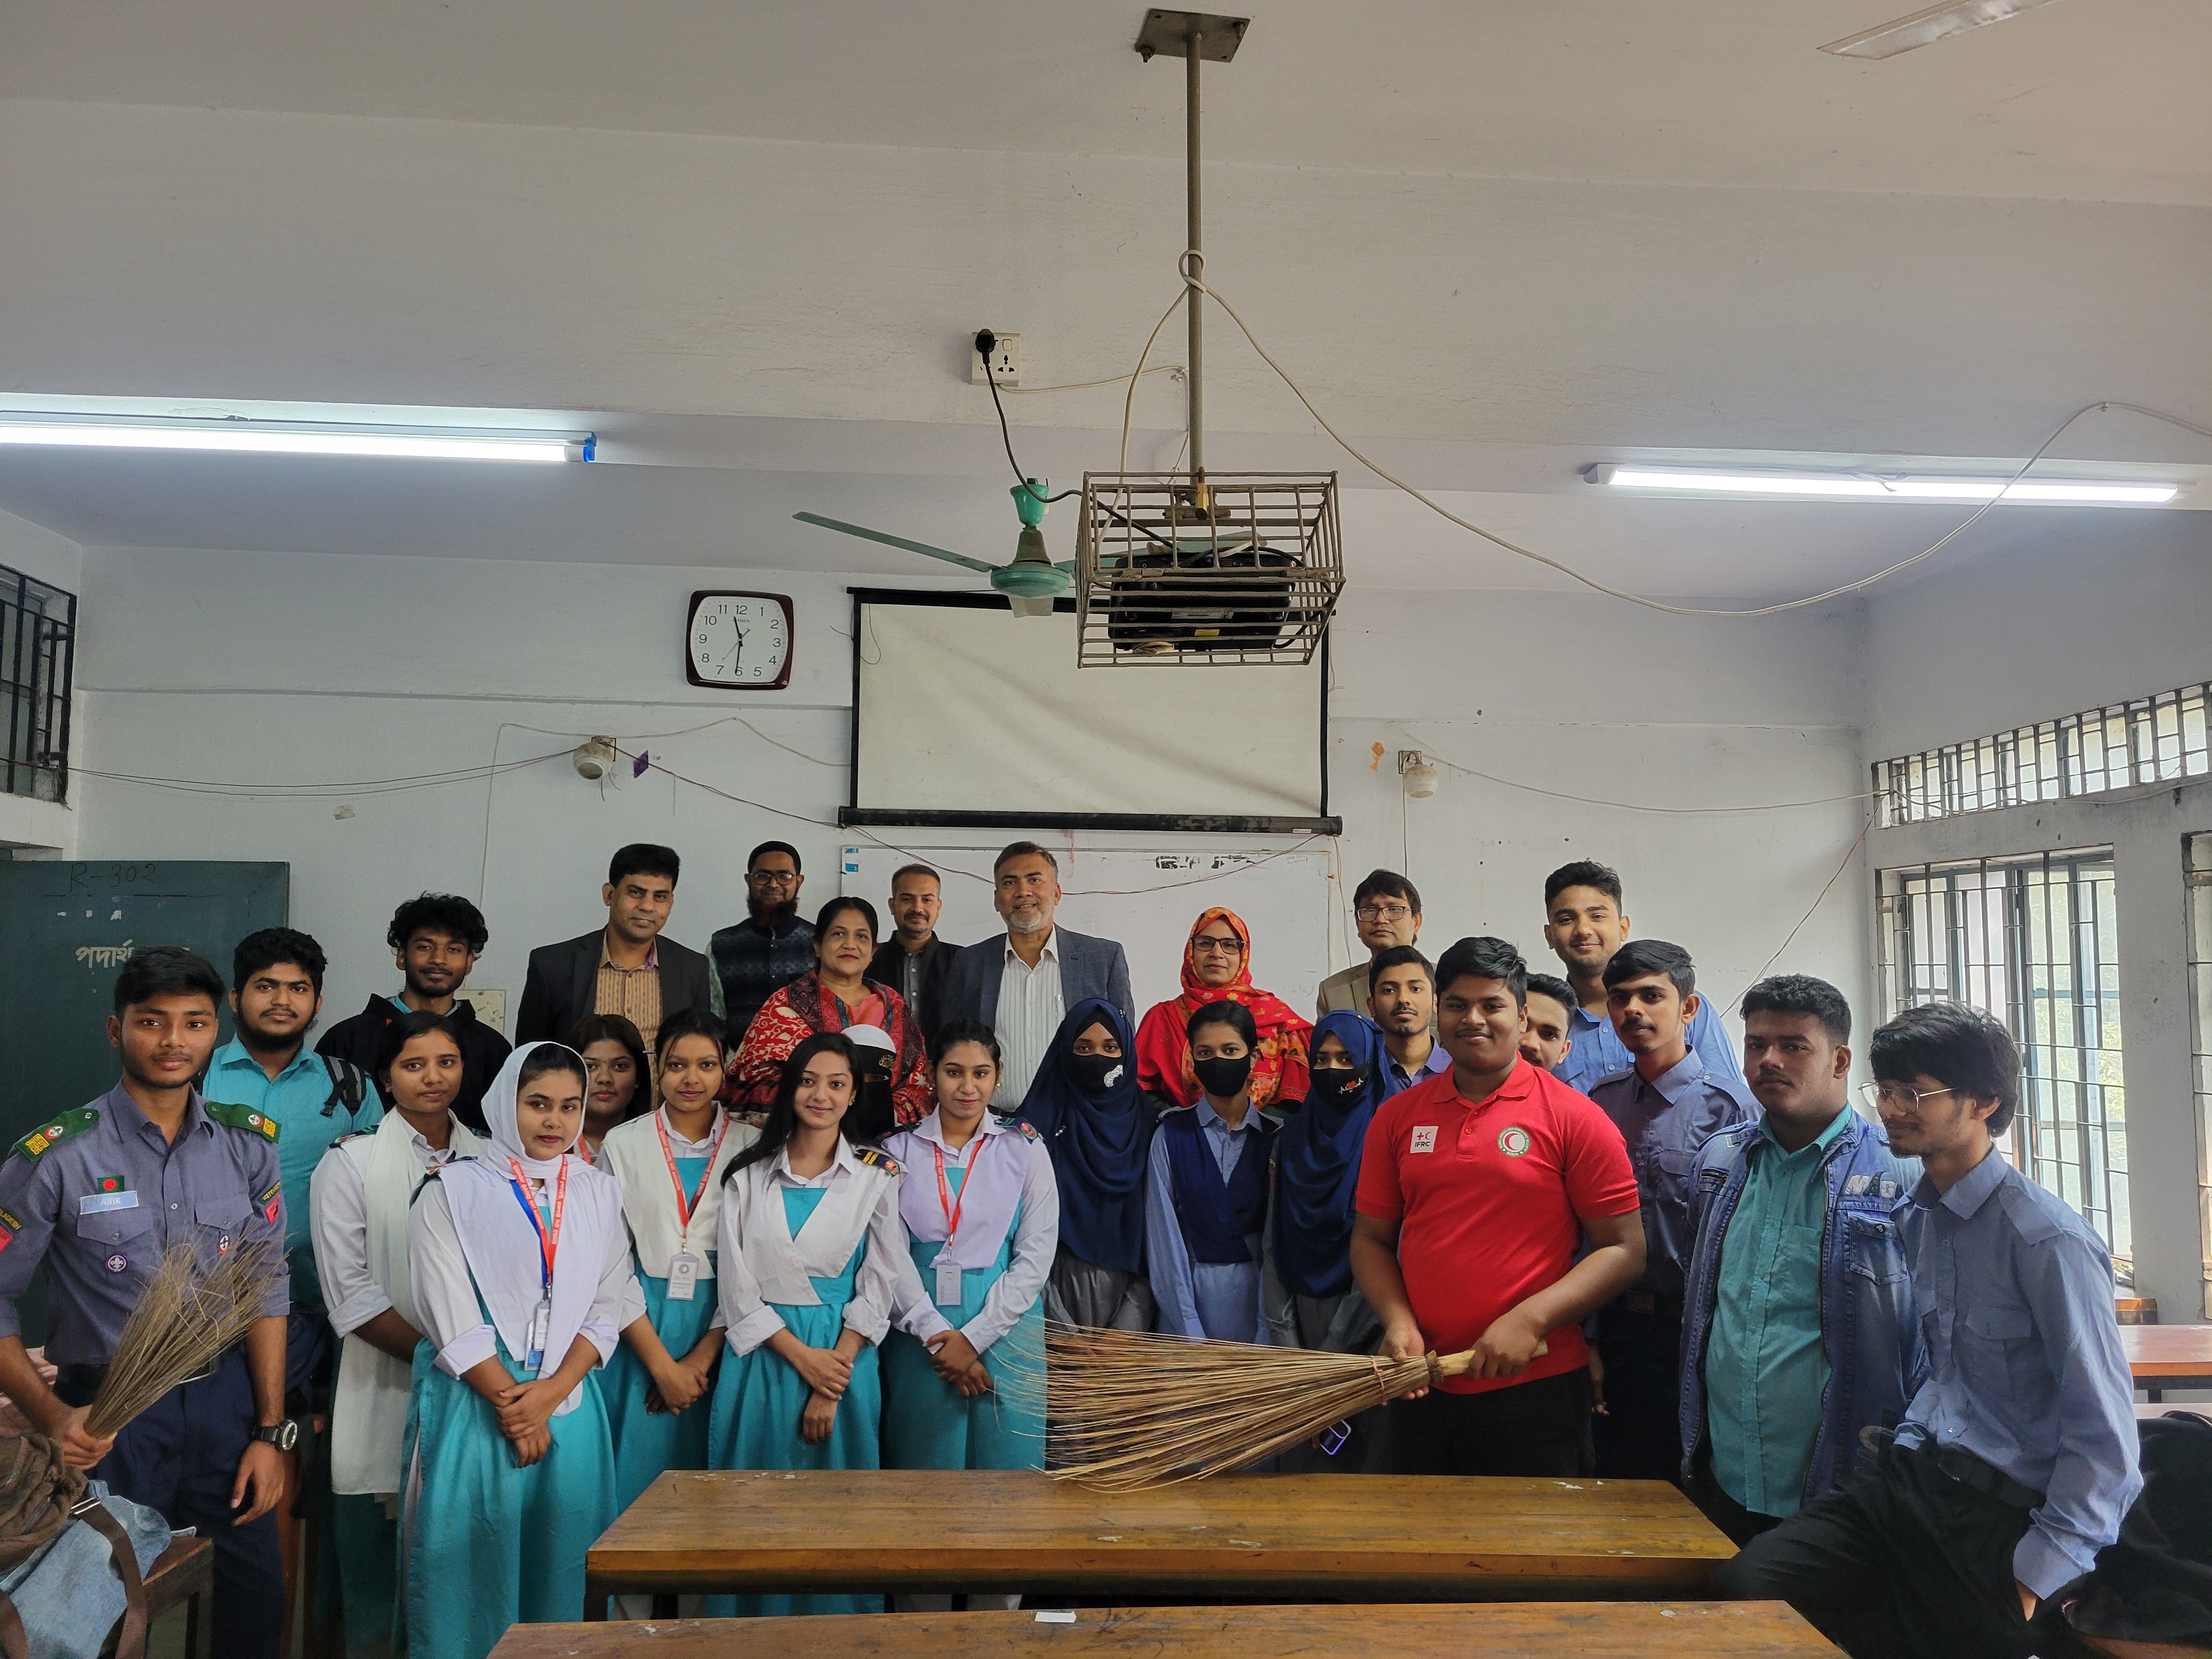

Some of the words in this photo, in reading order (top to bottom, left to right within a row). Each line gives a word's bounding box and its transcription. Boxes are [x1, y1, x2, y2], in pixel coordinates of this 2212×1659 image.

[718, 604, 727, 614] 11
[735, 605, 748, 615] 12
[760, 606, 764, 616] 1
[704, 615, 717, 625] 10
[770, 619, 779, 629] 2
[699, 634, 707, 644] 9
[772, 637, 781, 647] 3
[701, 653, 709, 663] 8
[769, 655, 777, 665] 4
[716, 665, 724, 675] 7
[735, 666, 743, 676] 6
[753, 667, 762, 676] 5
[100, 1197, 121, 1206] ANIK
[0, 1208, 22, 1230] LADESH
